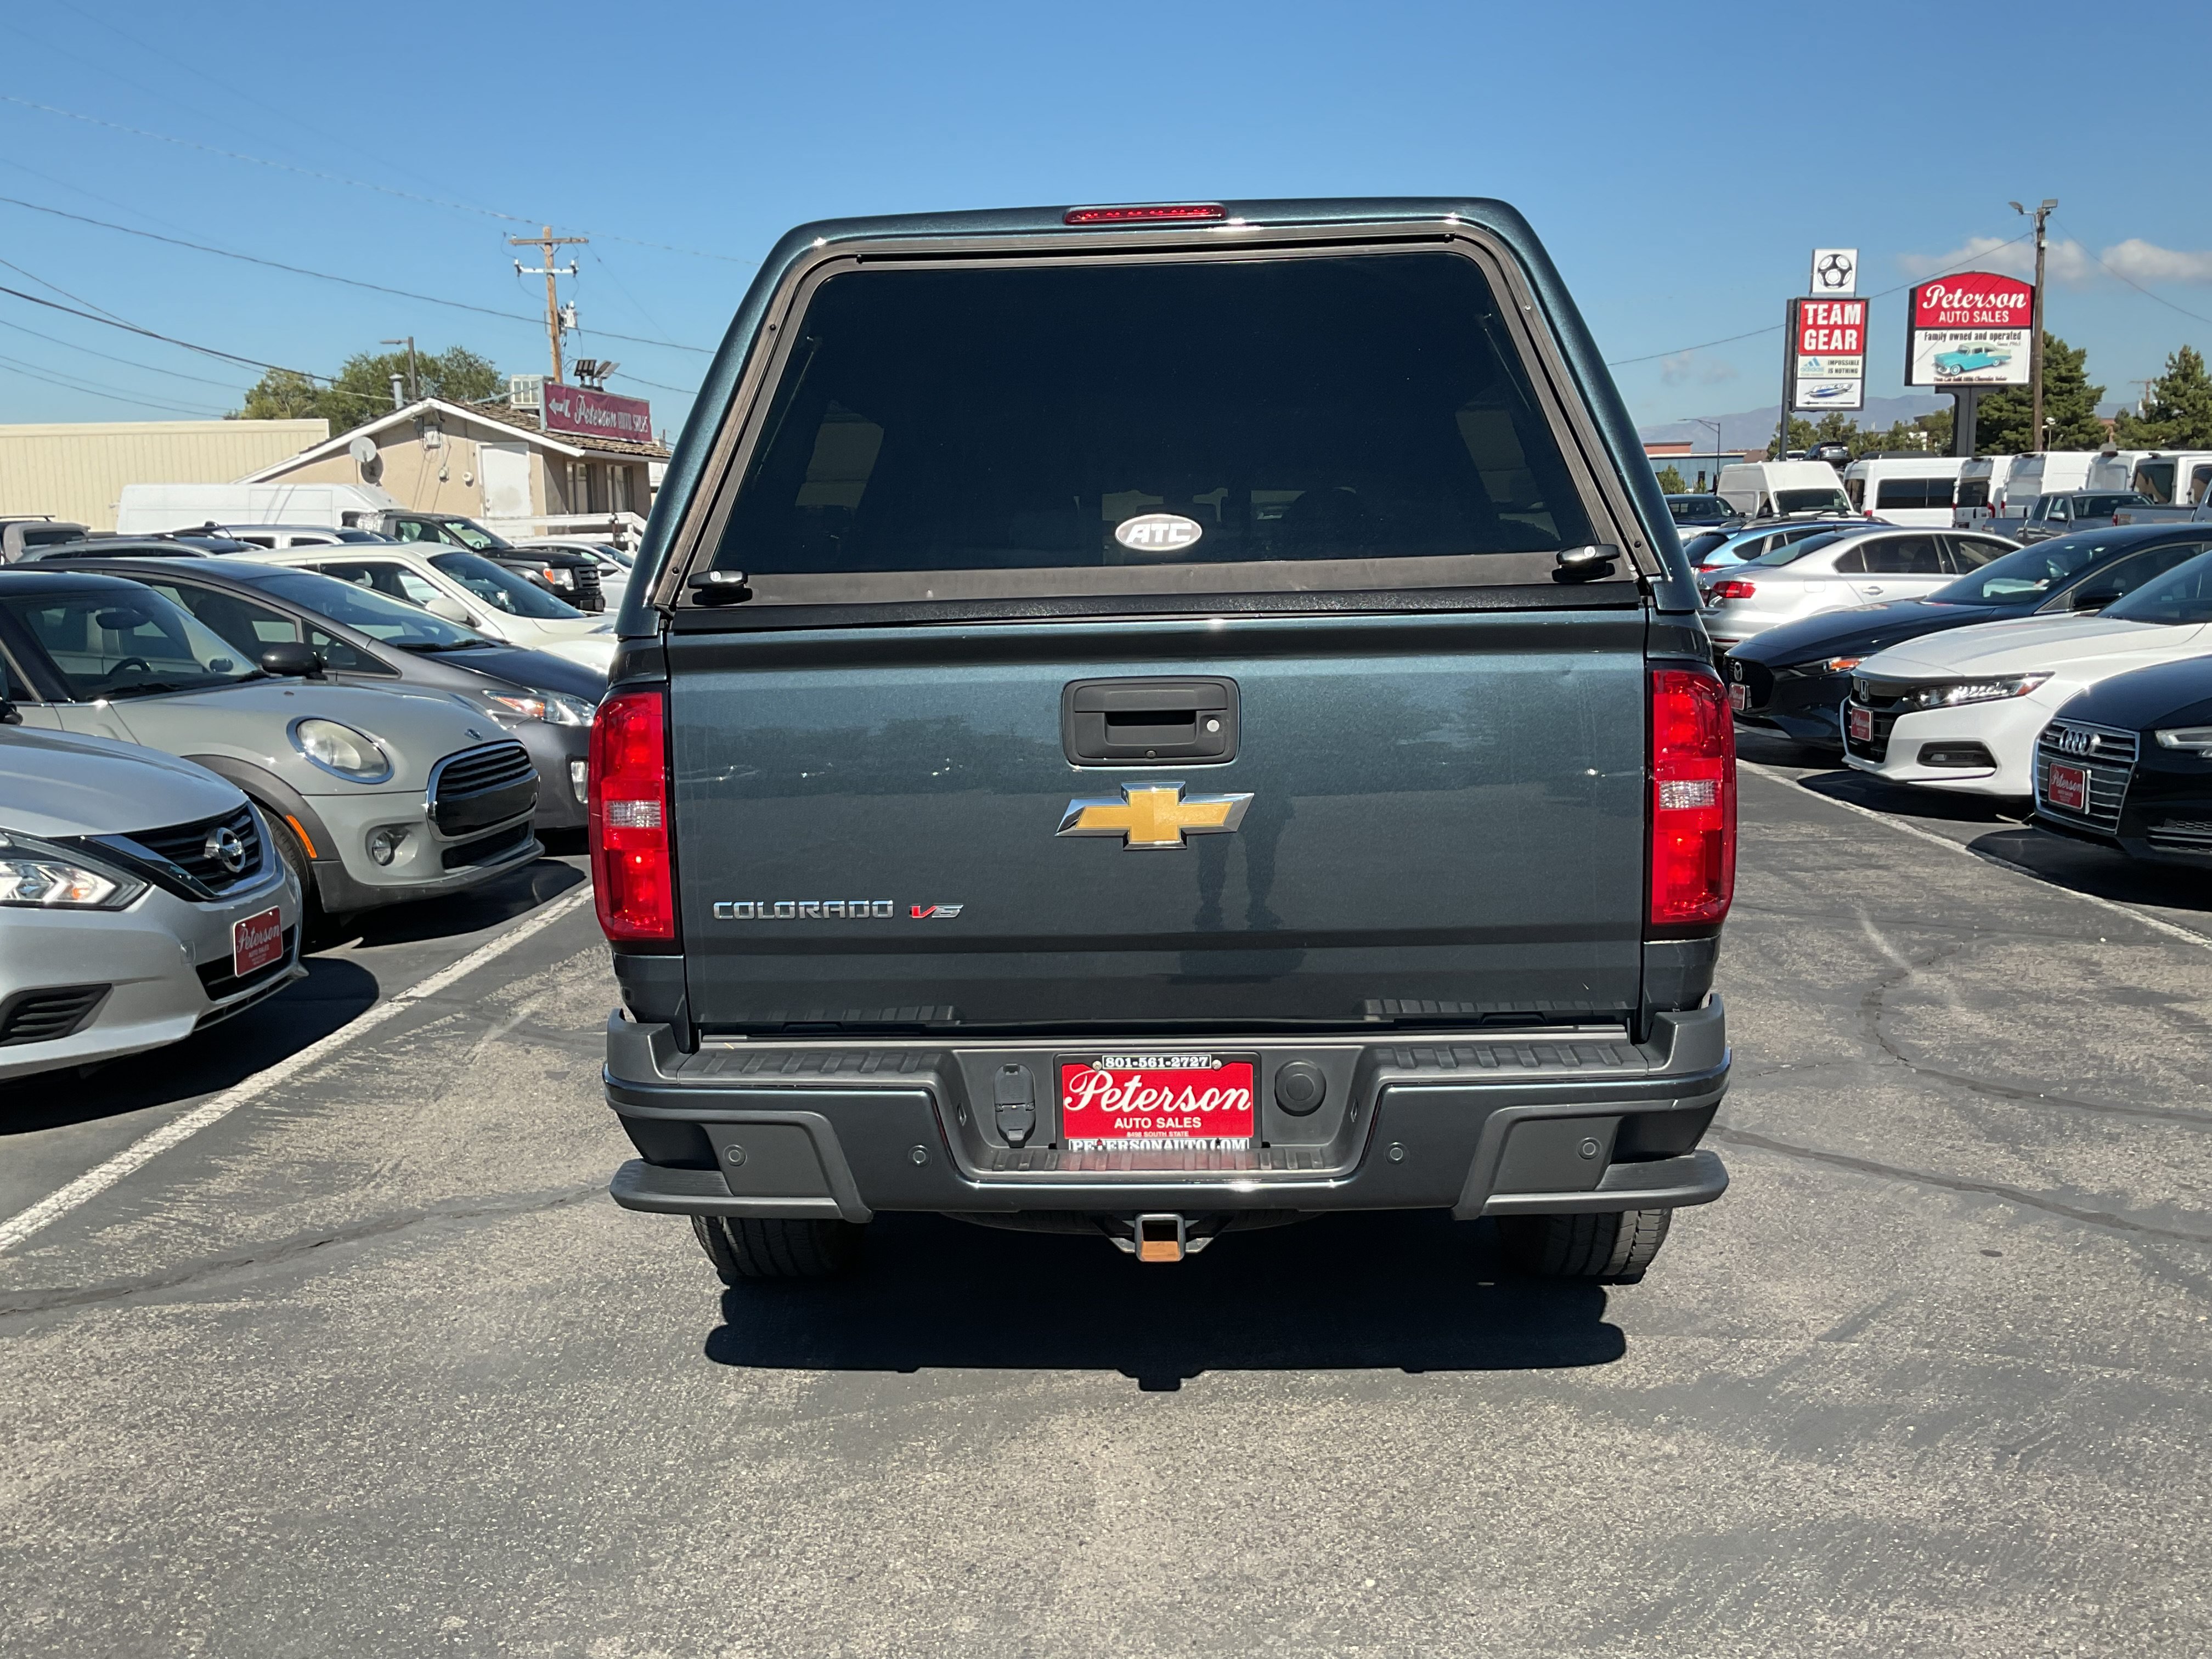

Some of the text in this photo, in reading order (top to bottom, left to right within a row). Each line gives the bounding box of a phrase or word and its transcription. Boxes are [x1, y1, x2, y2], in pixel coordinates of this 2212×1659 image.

[1922, 285, 2026, 309] Peterson
[1804, 303, 1861, 325] TEAM
[1939, 311, 2009, 323] AUTO SALES
[1804, 329, 1857, 351] GEAR
[1924, 331, 2022, 342] Family owned and operated
[574, 394, 618, 428] Peterson
[1126, 523, 1192, 543] ATC
[2051, 769, 2082, 792] Peterson
[713, 900, 964, 920] COLORADO V6
[236, 924, 280, 953] Peterson
[1105, 1057, 1208, 1068] 801-561-2727
[1064, 1070, 1251, 1113] Peterson
[1114, 1117, 1202, 1128] AUTO SALES
[1072, 1139, 1246, 1150] PETERSONAUTOCOM
